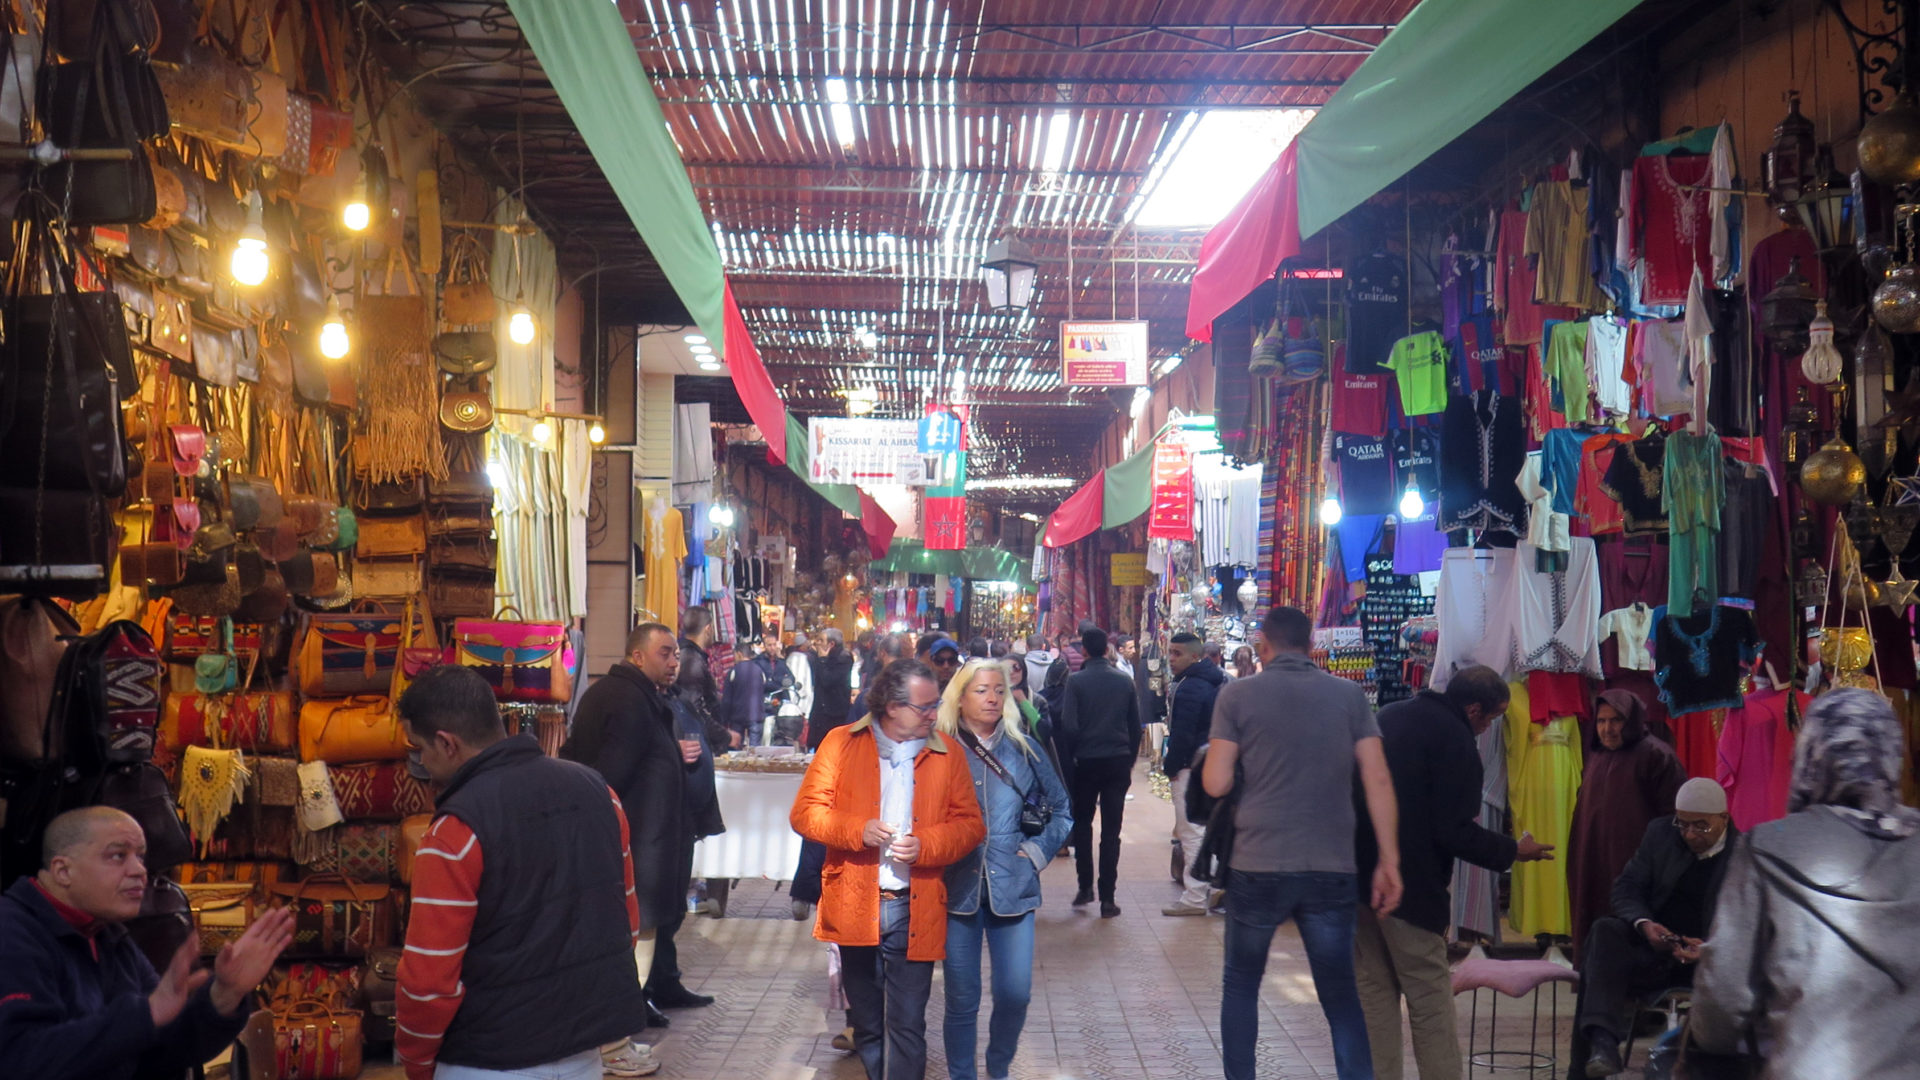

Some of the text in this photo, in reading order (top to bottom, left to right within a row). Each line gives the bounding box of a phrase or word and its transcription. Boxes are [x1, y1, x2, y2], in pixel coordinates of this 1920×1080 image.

[1358, 291, 1398, 303] Emirates
[1471, 347, 1504, 360] QATAR
[1345, 380, 1378, 388] Emirates
[828, 438, 872, 446] KISSARIAT
[1348, 443, 1383, 457] QATAR
[975, 745, 1002, 774] EOS DIGITAL
